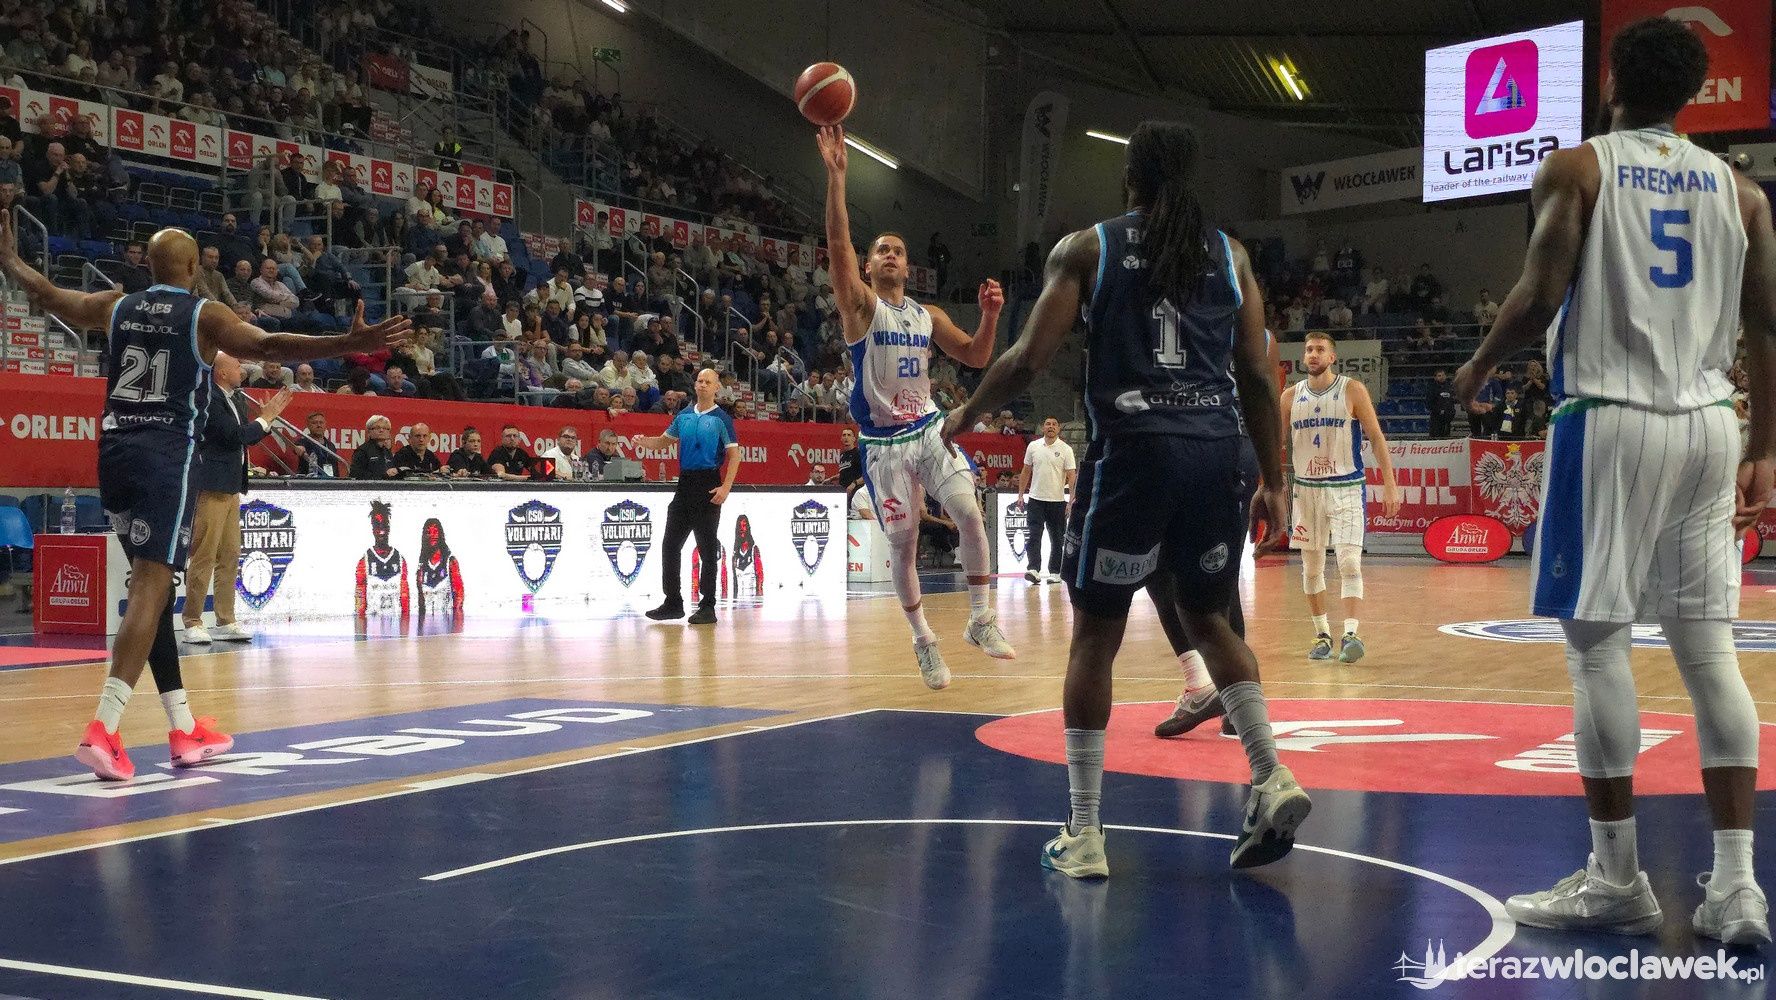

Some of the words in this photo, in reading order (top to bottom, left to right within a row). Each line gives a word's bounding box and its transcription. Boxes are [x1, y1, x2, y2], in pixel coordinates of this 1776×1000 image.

[120, 135, 141, 145] ORLEN
[148, 139, 167, 149] ORLEN
[173, 144, 193, 154] ORLEN
[199, 149, 217, 158] ORLEN
[1444, 135, 1559, 175] Larisa
[374, 182, 390, 190] ORLEN
[1333, 165, 1416, 193] WŁOCŁAWEK
[1431, 180, 1459, 193] leader
[1462, 177, 1472, 189] of
[1474, 176, 1491, 187] the
[1492, 171, 1528, 186] railway
[1617, 164, 1718, 195] FREEMAN
[395, 185, 410, 193] ORLEN
[1650, 208, 1694, 289] 5
[873, 330, 929, 348] WŁOCŁAW
[1152, 298, 1187, 369] 1
[110, 345, 170, 403] 21
[898, 357, 920, 378] 20
[1295, 357, 1376, 375] Lisa
[11, 413, 96, 441] ORLEN
[1293, 418, 1346, 431] WŁOCŁAWEK
[303, 427, 366, 450] LEN
[428, 432, 464, 454] ORL
[1313, 433, 1321, 448] 4
[739, 446, 767, 463] RLEN
[806, 448, 841, 464] ORLEN
[987, 454, 1013, 469] ORLEN
[1305, 459, 1337, 477] Anwil
[1365, 467, 1457, 505] NWIL
[247, 511, 268, 527] CSO
[527, 509, 543, 523] CSO
[620, 509, 634, 521] CSO
[506, 526, 561, 542] VOLUNTARI
[602, 525, 650, 540] VOLUNTARI
[791, 521, 829, 535] VOLUNTARI
[1446, 525, 1488, 545] Anwil
[240, 531, 294, 549] UNTARI
[50, 568, 89, 594] Anwil
